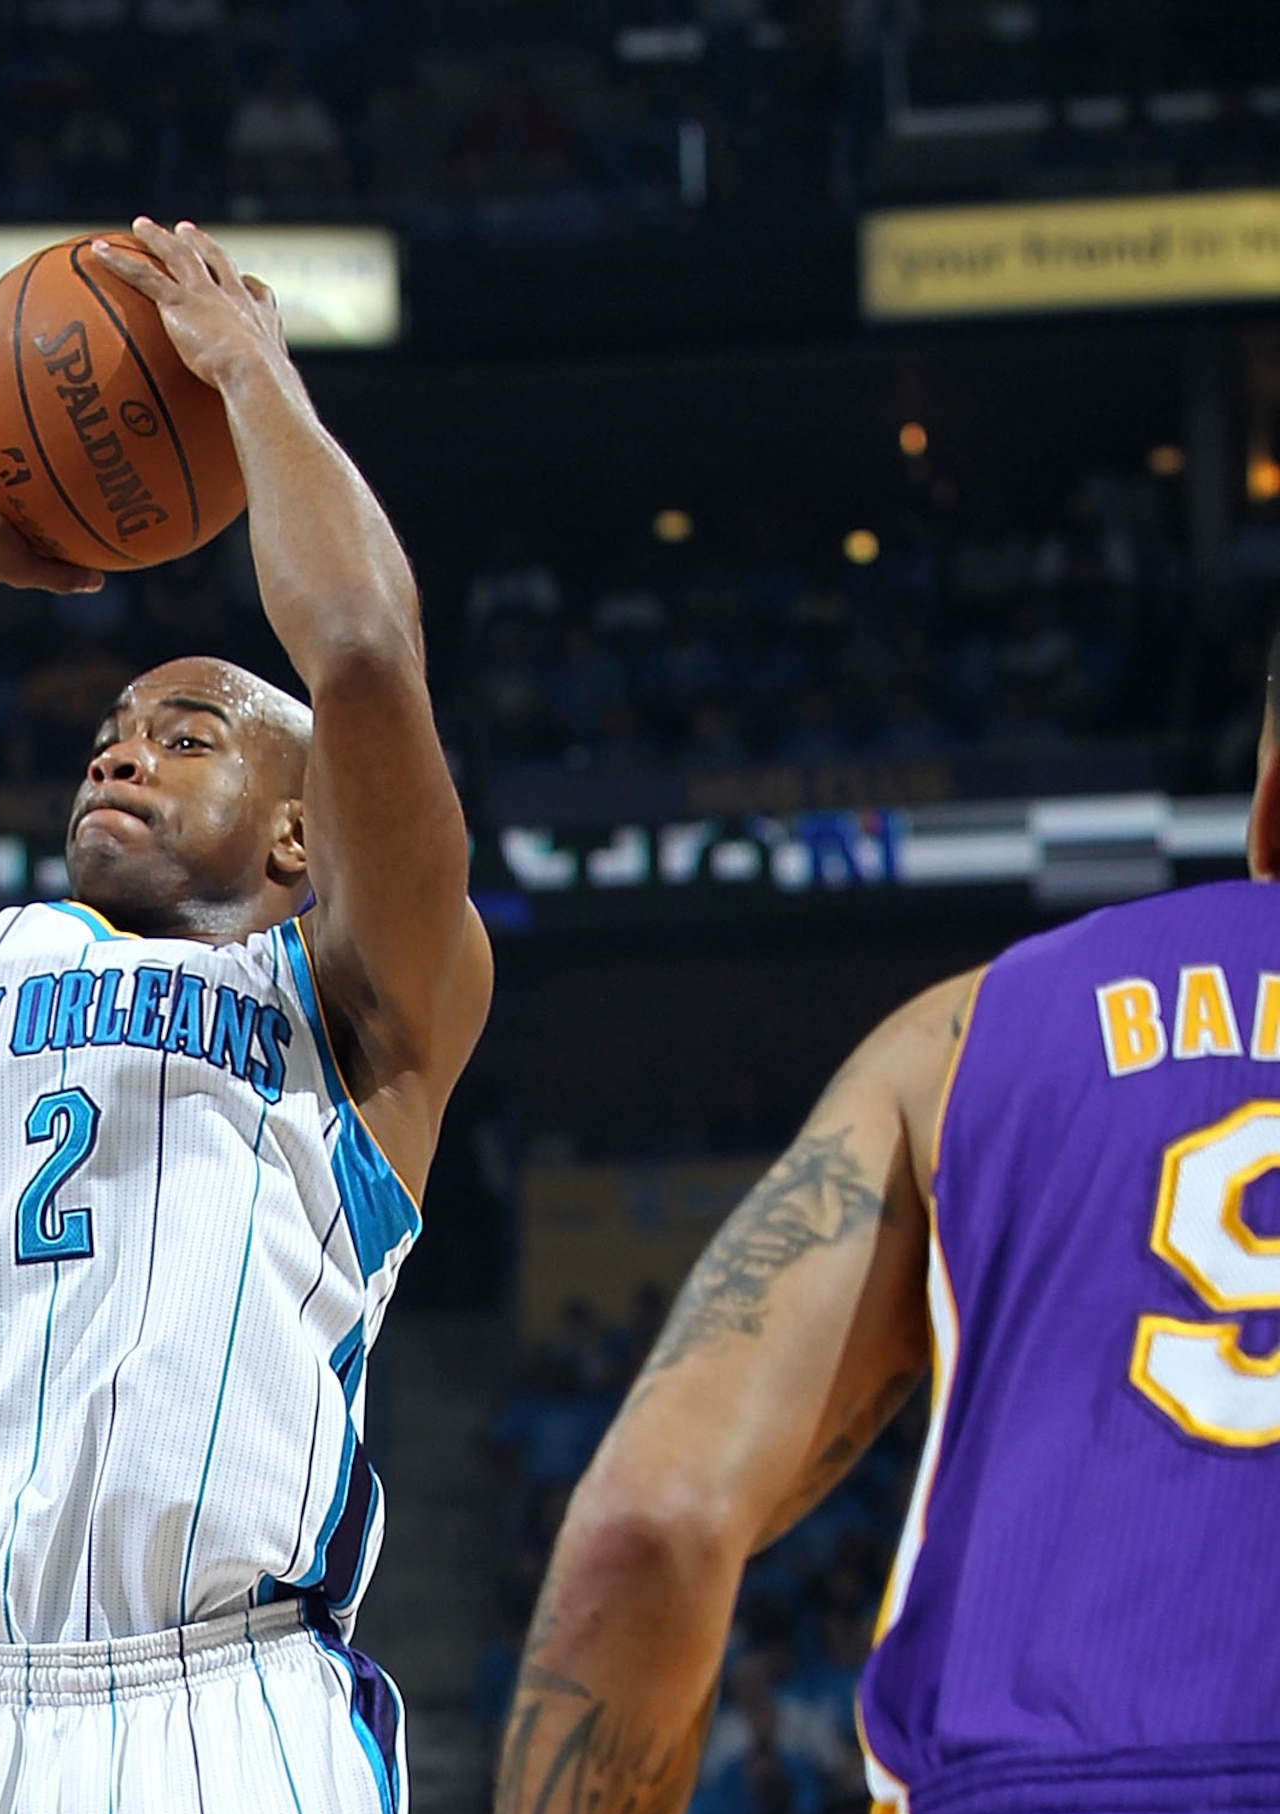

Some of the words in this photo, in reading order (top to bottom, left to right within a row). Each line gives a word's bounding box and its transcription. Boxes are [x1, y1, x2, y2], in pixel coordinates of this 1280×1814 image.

[33, 320, 169, 542] SPALDING
[9, 966, 292, 1105] ORLEANS
[15, 1086, 101, 1264] 2
